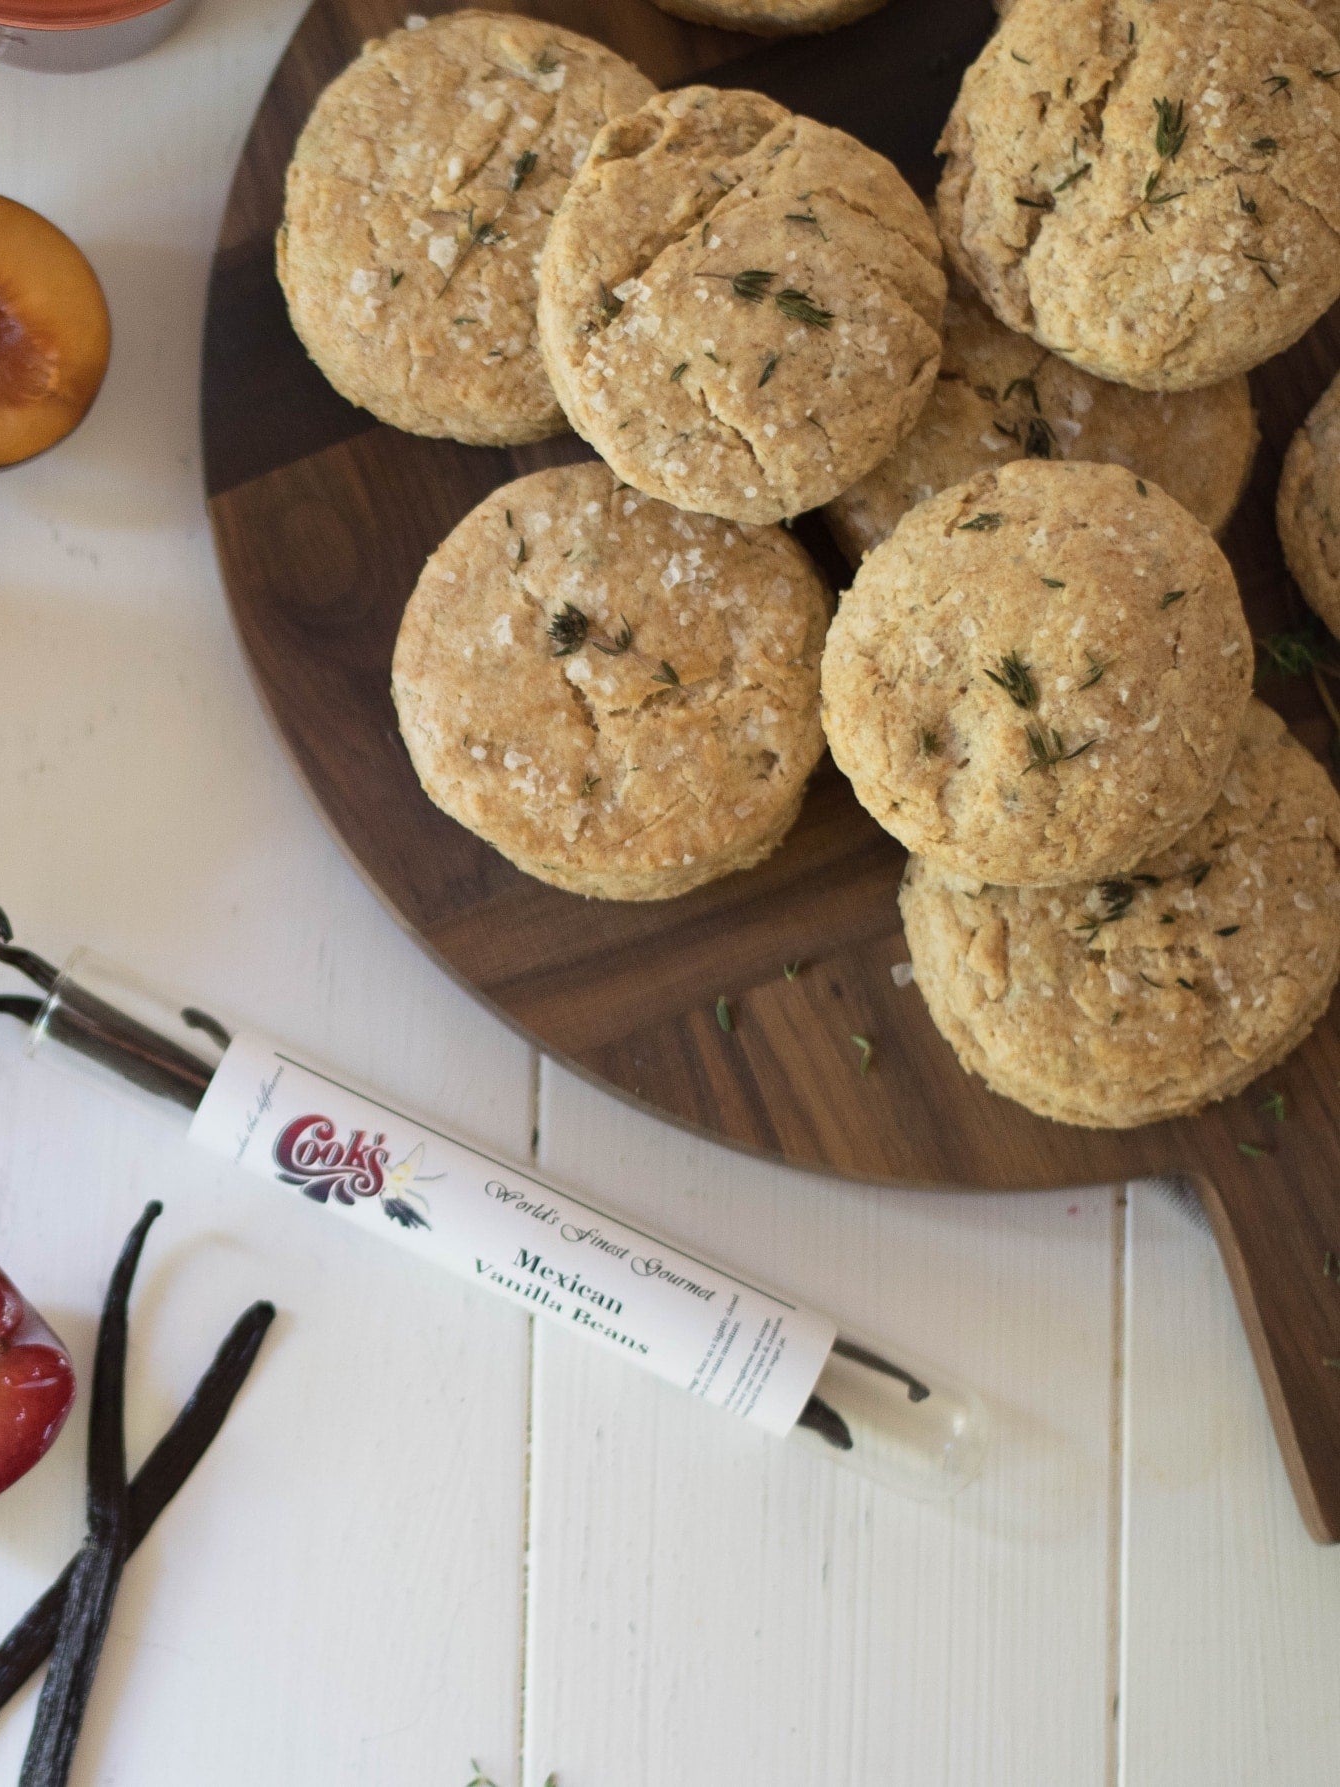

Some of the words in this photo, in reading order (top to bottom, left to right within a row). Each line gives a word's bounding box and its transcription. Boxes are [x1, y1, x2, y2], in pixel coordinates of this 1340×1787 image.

[271, 1113, 391, 1198] Cook's
[484, 1180, 560, 1226] World's
[560, 1223, 630, 1260] Finest
[630, 1257, 716, 1301] Gourmet
[512, 1246, 623, 1316] Mexican
[475, 1257, 563, 1313] Vanilla
[570, 1306, 649, 1354] Beans
